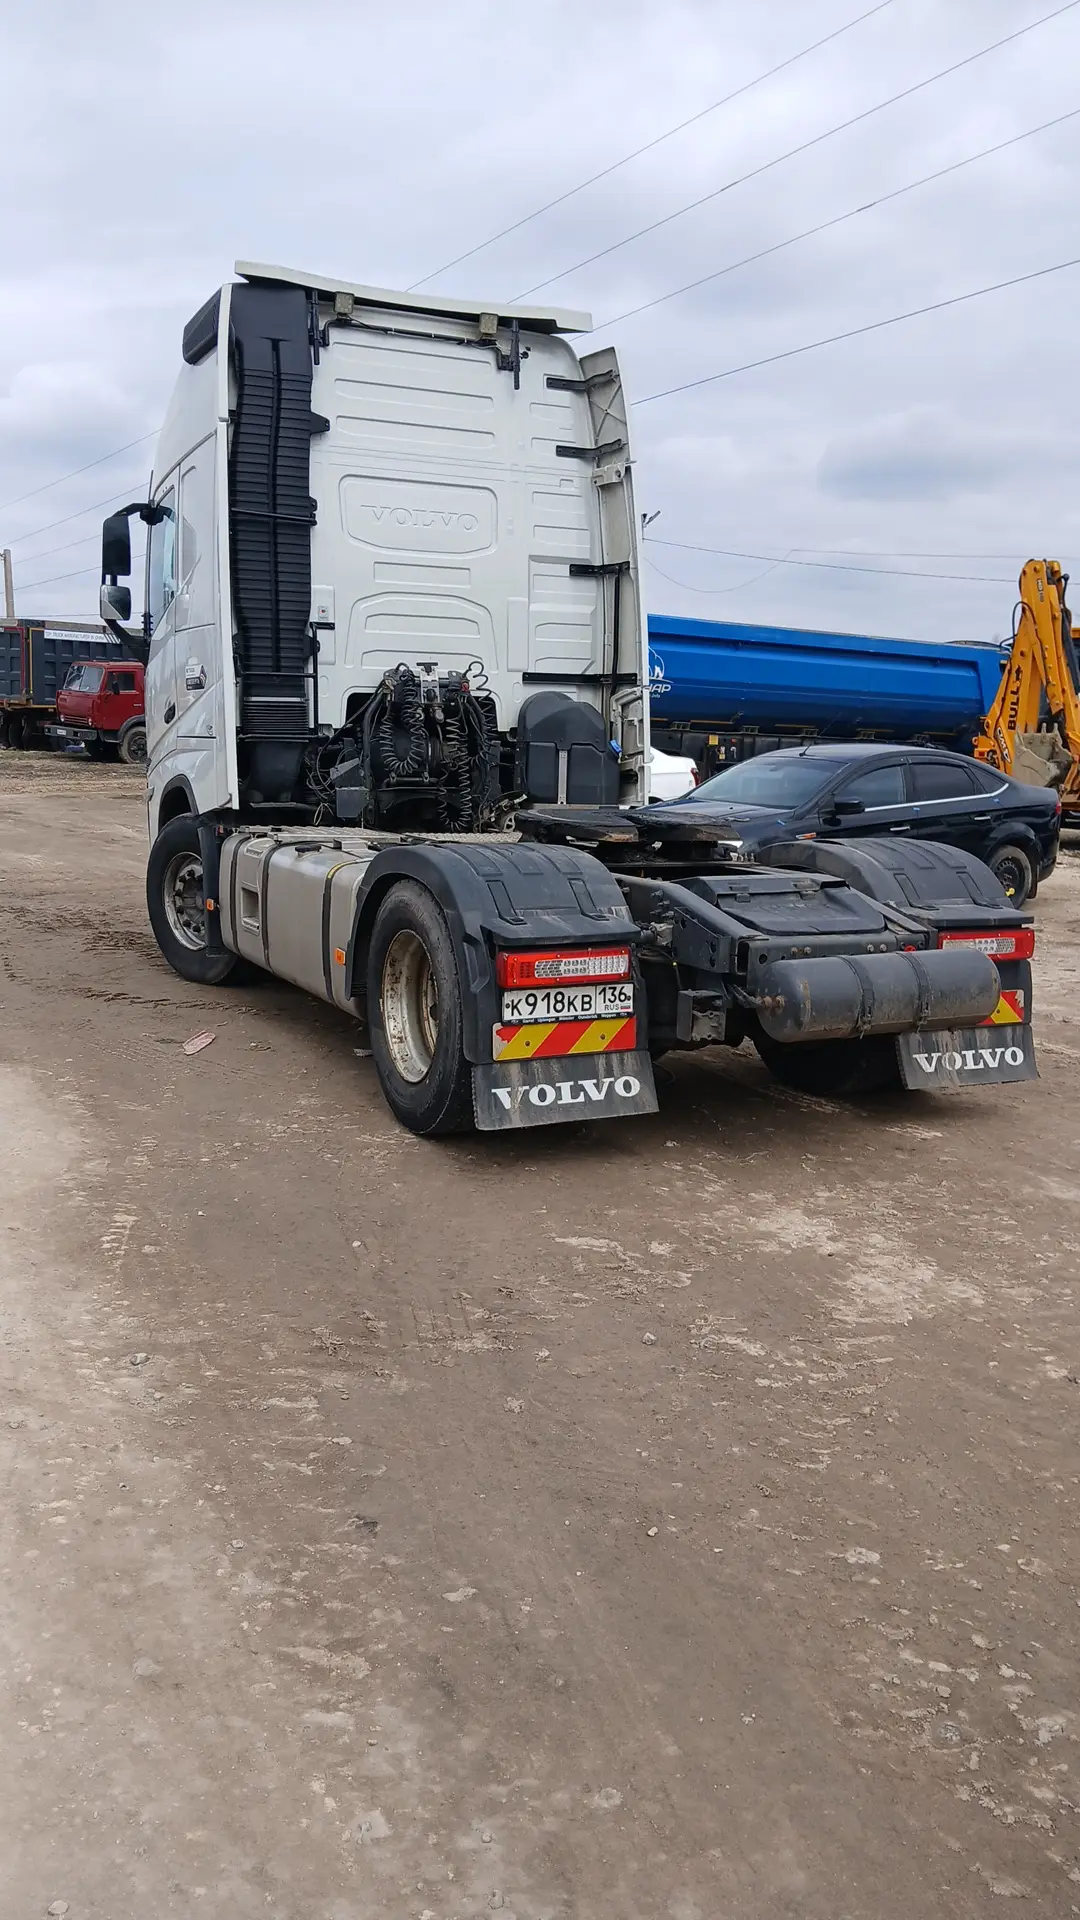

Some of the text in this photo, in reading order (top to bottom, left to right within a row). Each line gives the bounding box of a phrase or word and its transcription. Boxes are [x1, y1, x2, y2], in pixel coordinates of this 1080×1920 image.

[360, 504, 479, 532] VOLVO
[1008, 685, 1020, 731] BULL
[598, 986, 628, 1004] 136
[913, 1046, 1024, 1073] VOLVO
[491, 1075, 641, 1110] VOLVO
